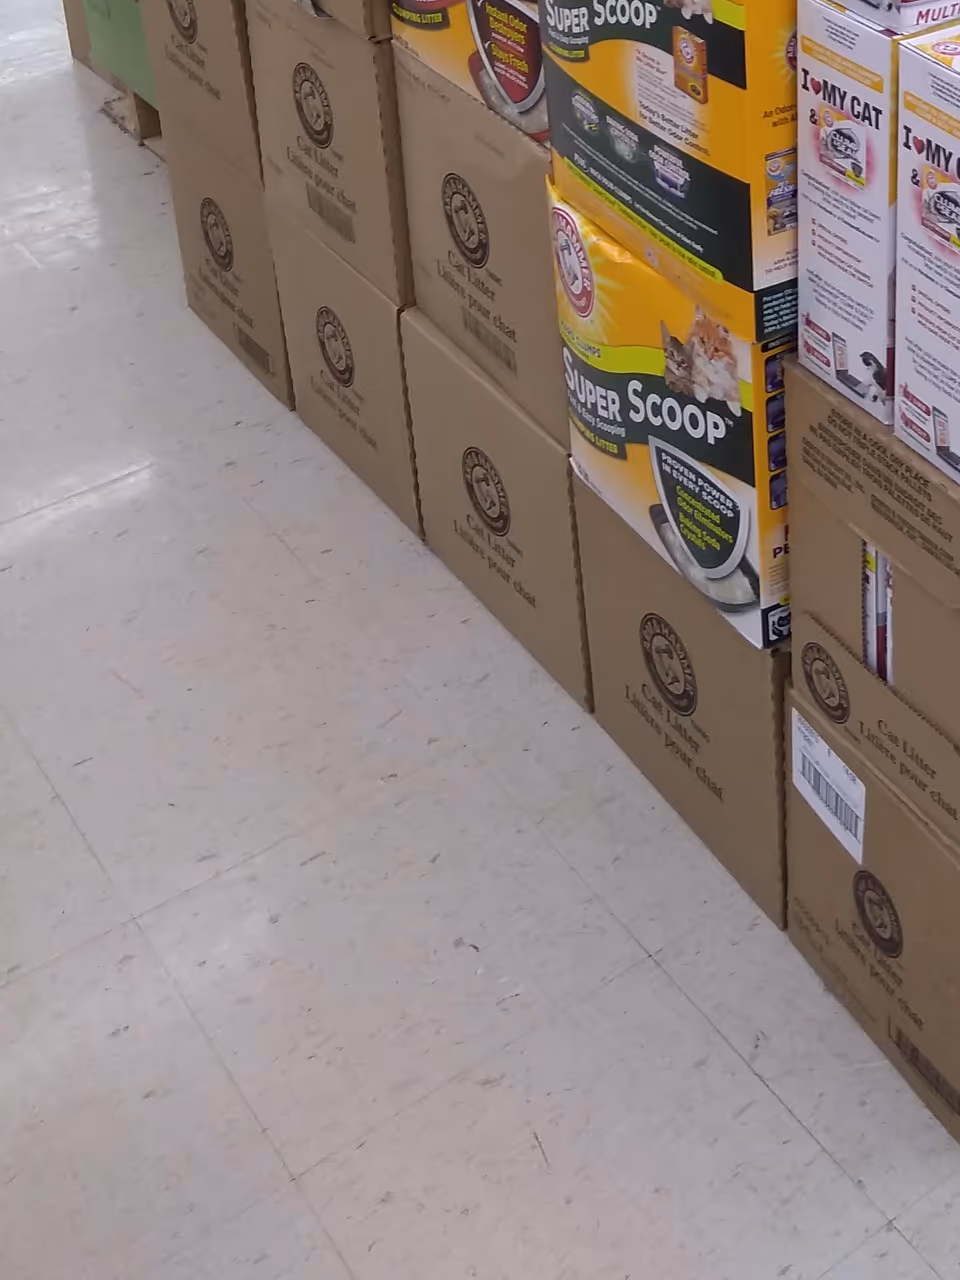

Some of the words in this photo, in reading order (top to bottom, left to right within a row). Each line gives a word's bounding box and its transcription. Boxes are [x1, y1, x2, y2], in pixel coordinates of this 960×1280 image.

[809, 109, 818, 125] &
[903, 125, 912, 151] I
[926, 138, 953, 173] MY
[911, 168, 921, 187] &
[562, 346, 621, 422] SUPER
[627, 380, 726, 445] SCOOP
[662, 463, 671, 475] IN
[673, 470, 699, 493] EVERY
[701, 491, 734, 518] SCOOP
